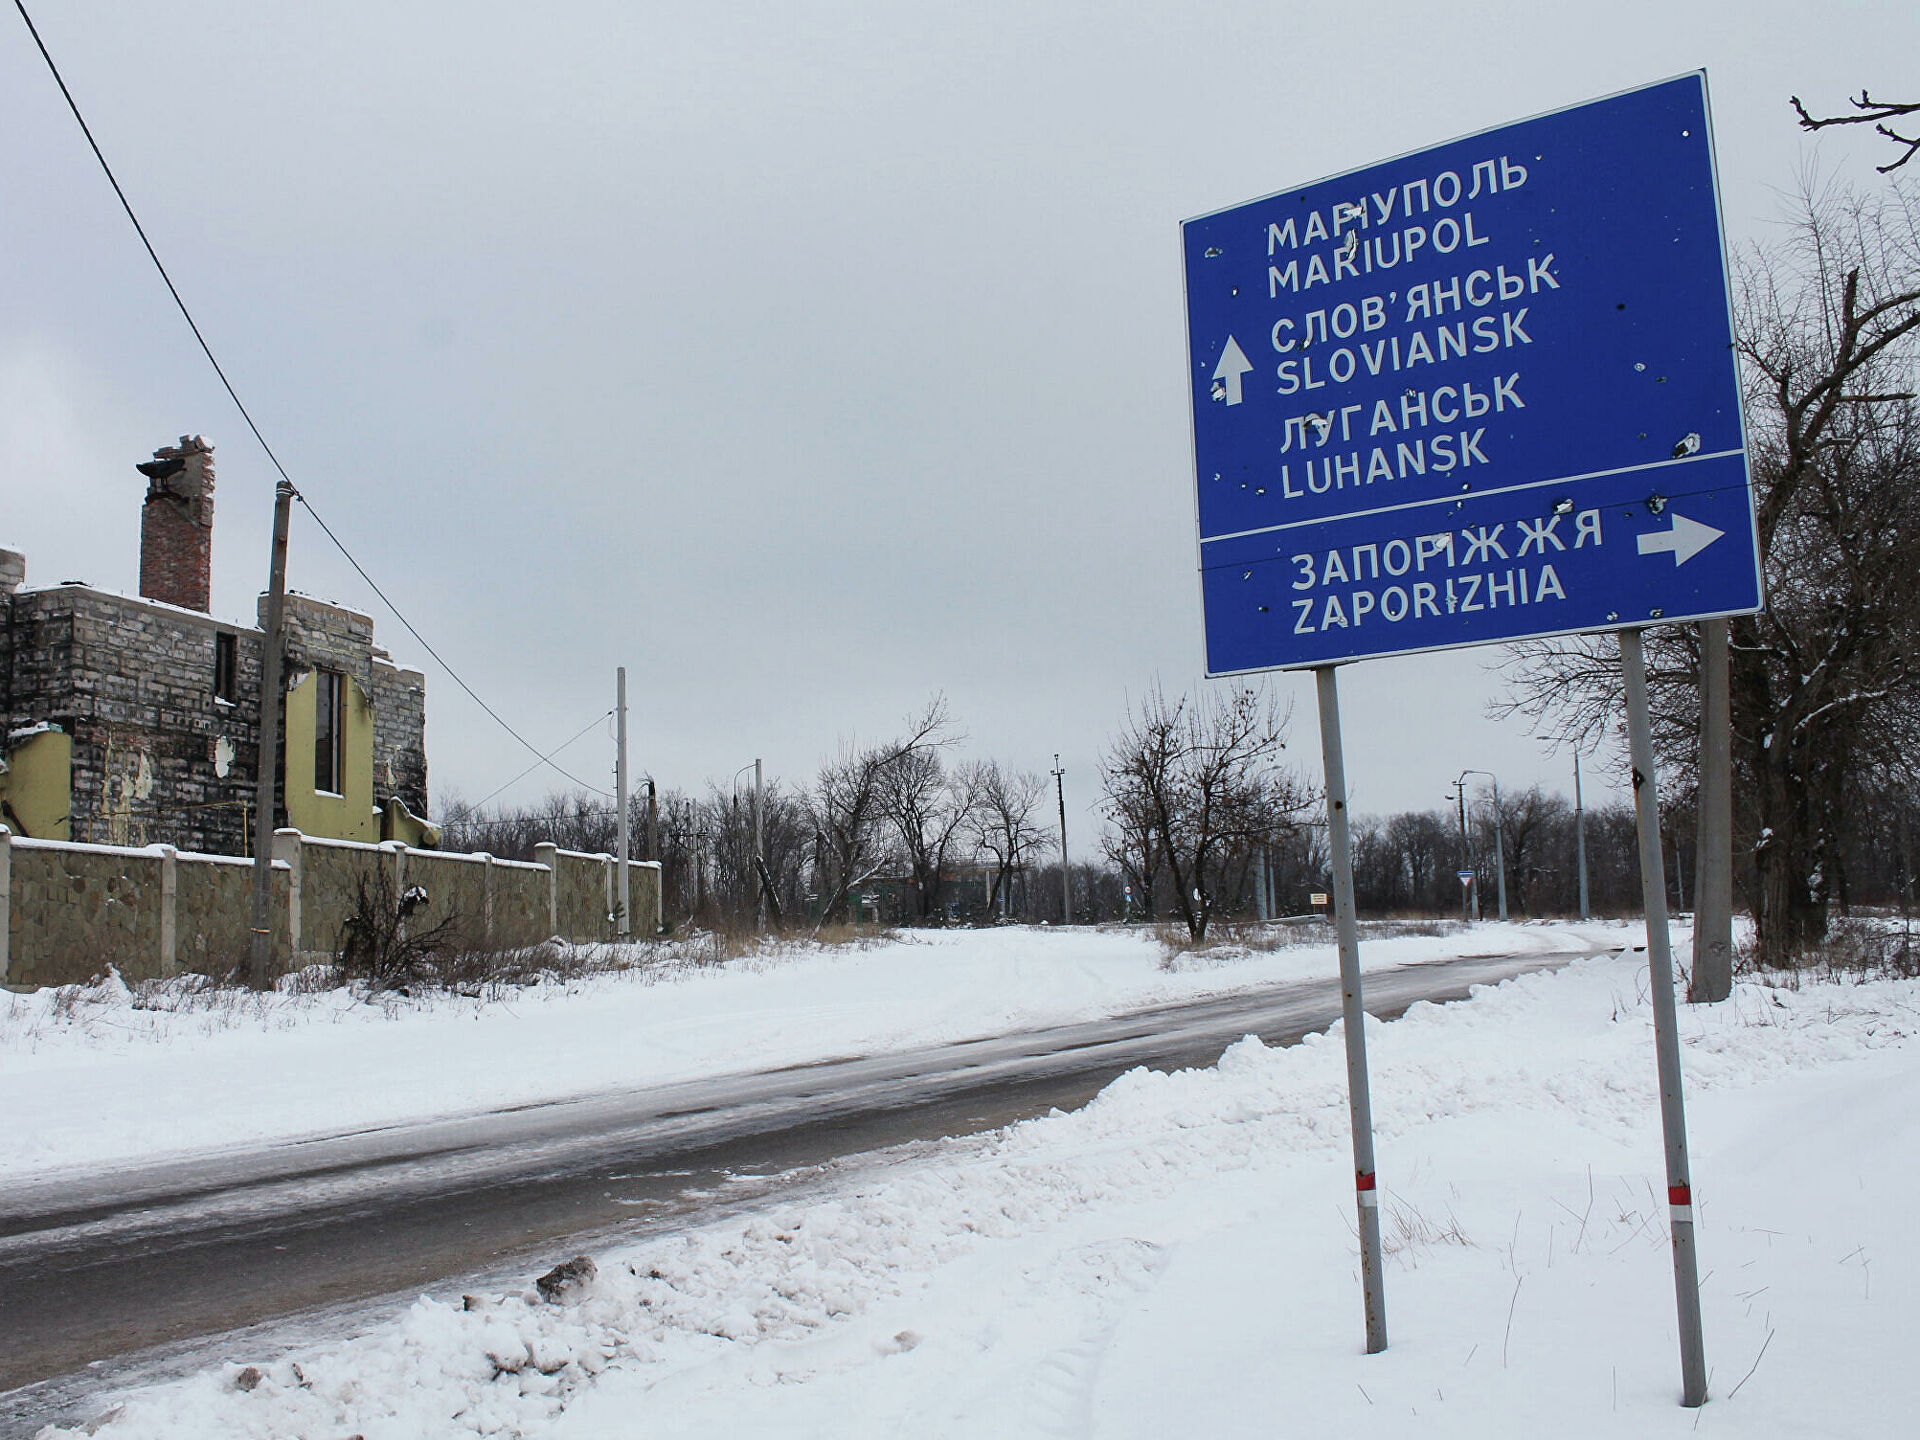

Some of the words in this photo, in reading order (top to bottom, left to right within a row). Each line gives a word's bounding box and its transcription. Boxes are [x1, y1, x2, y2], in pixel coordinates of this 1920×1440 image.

[1267, 155, 1528, 255] МАРІУПОЛЬ
[1268, 212, 1490, 298] MARIUPOL
[1277, 307, 1533, 395] SLOVIANSK
[1280, 372, 1526, 454] ЛУГАНСЬК
[1281, 427, 1490, 499] LUHANSK
[1291, 508, 1603, 591] ЗАПОРІЖЖЯ
[1291, 564, 1566, 635] ZAPORIZHIA
